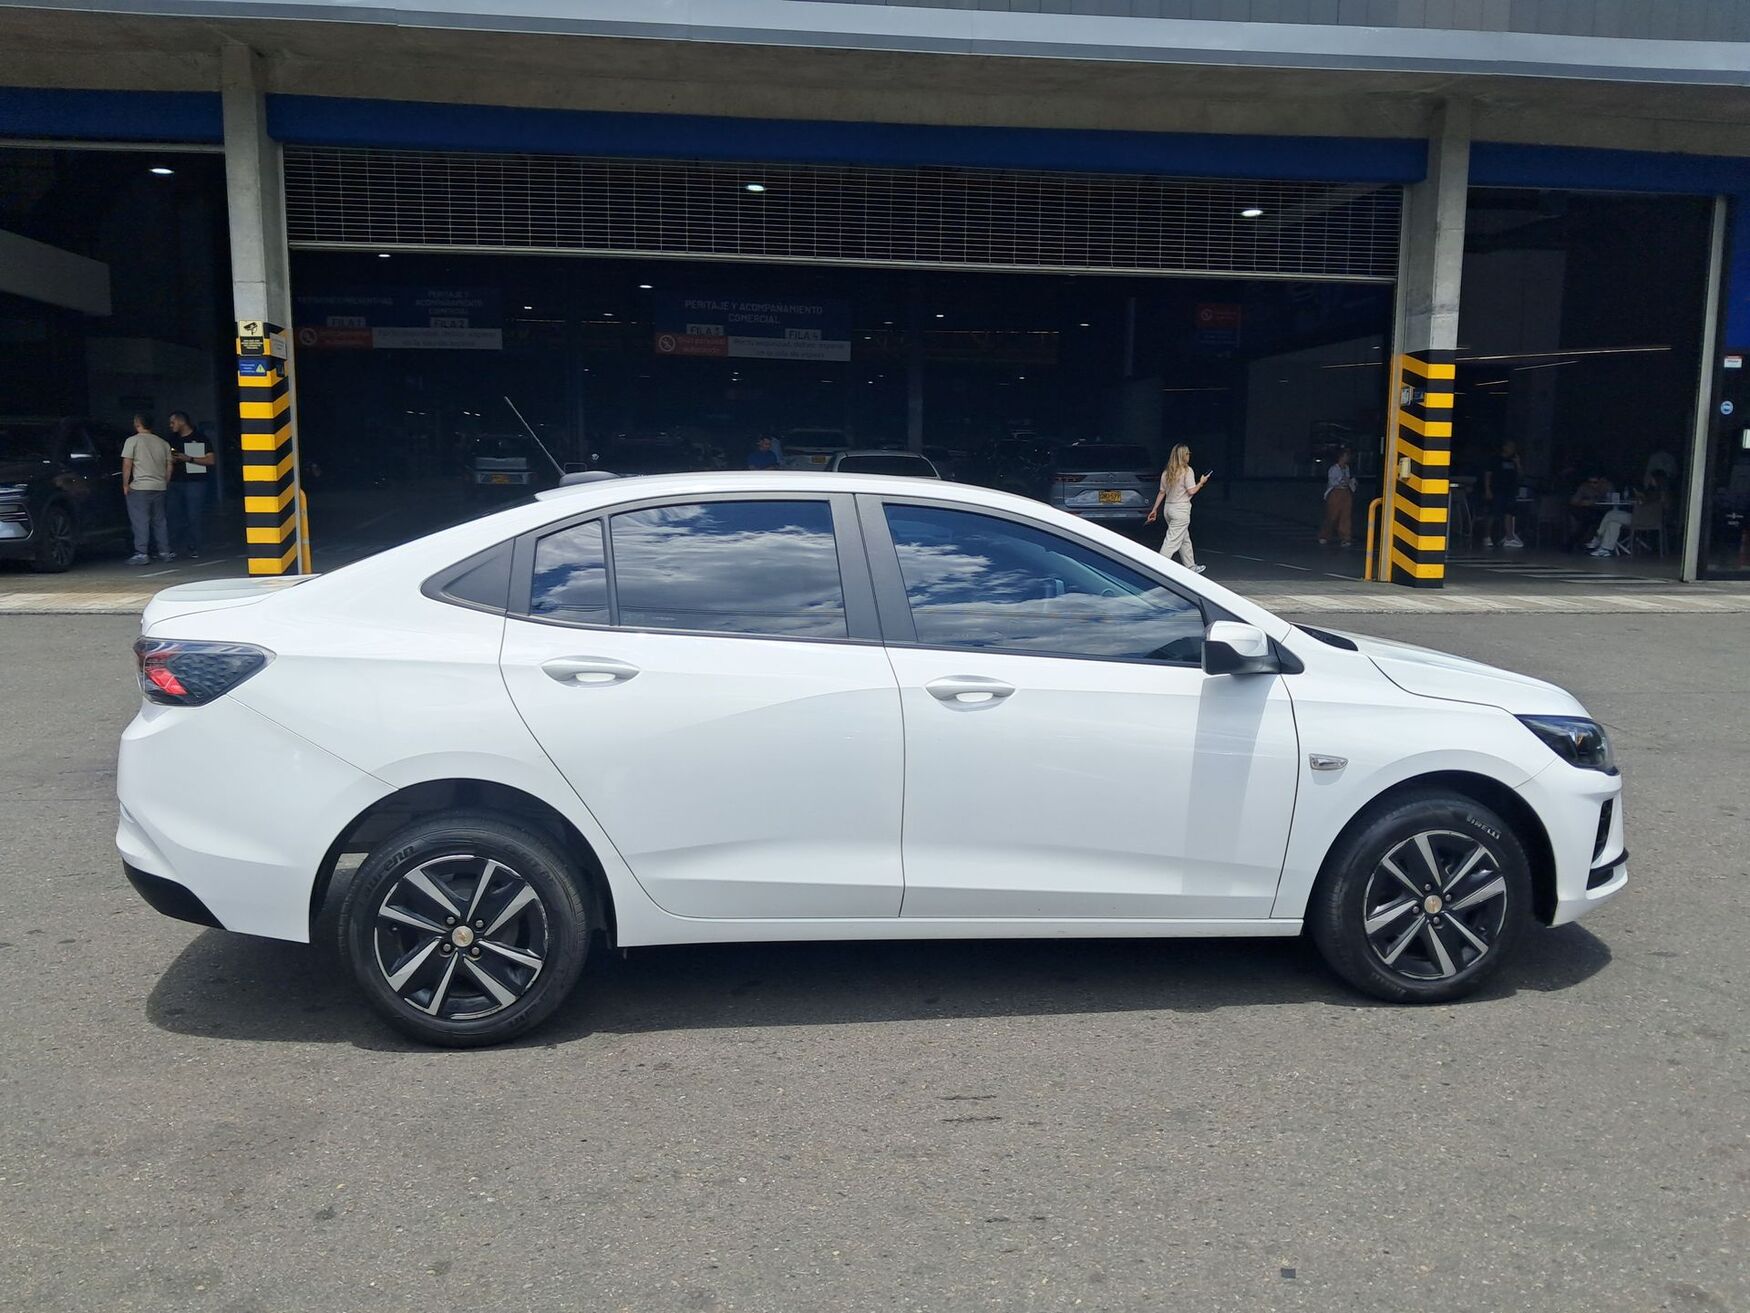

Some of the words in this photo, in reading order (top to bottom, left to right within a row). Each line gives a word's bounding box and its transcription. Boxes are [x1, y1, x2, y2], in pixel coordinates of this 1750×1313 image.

[684, 299, 729, 311] PERITAJE
[728, 313, 780, 324] COMERCIAL
[690, 326, 712, 336] FILA
[789, 330, 810, 340] FILA
